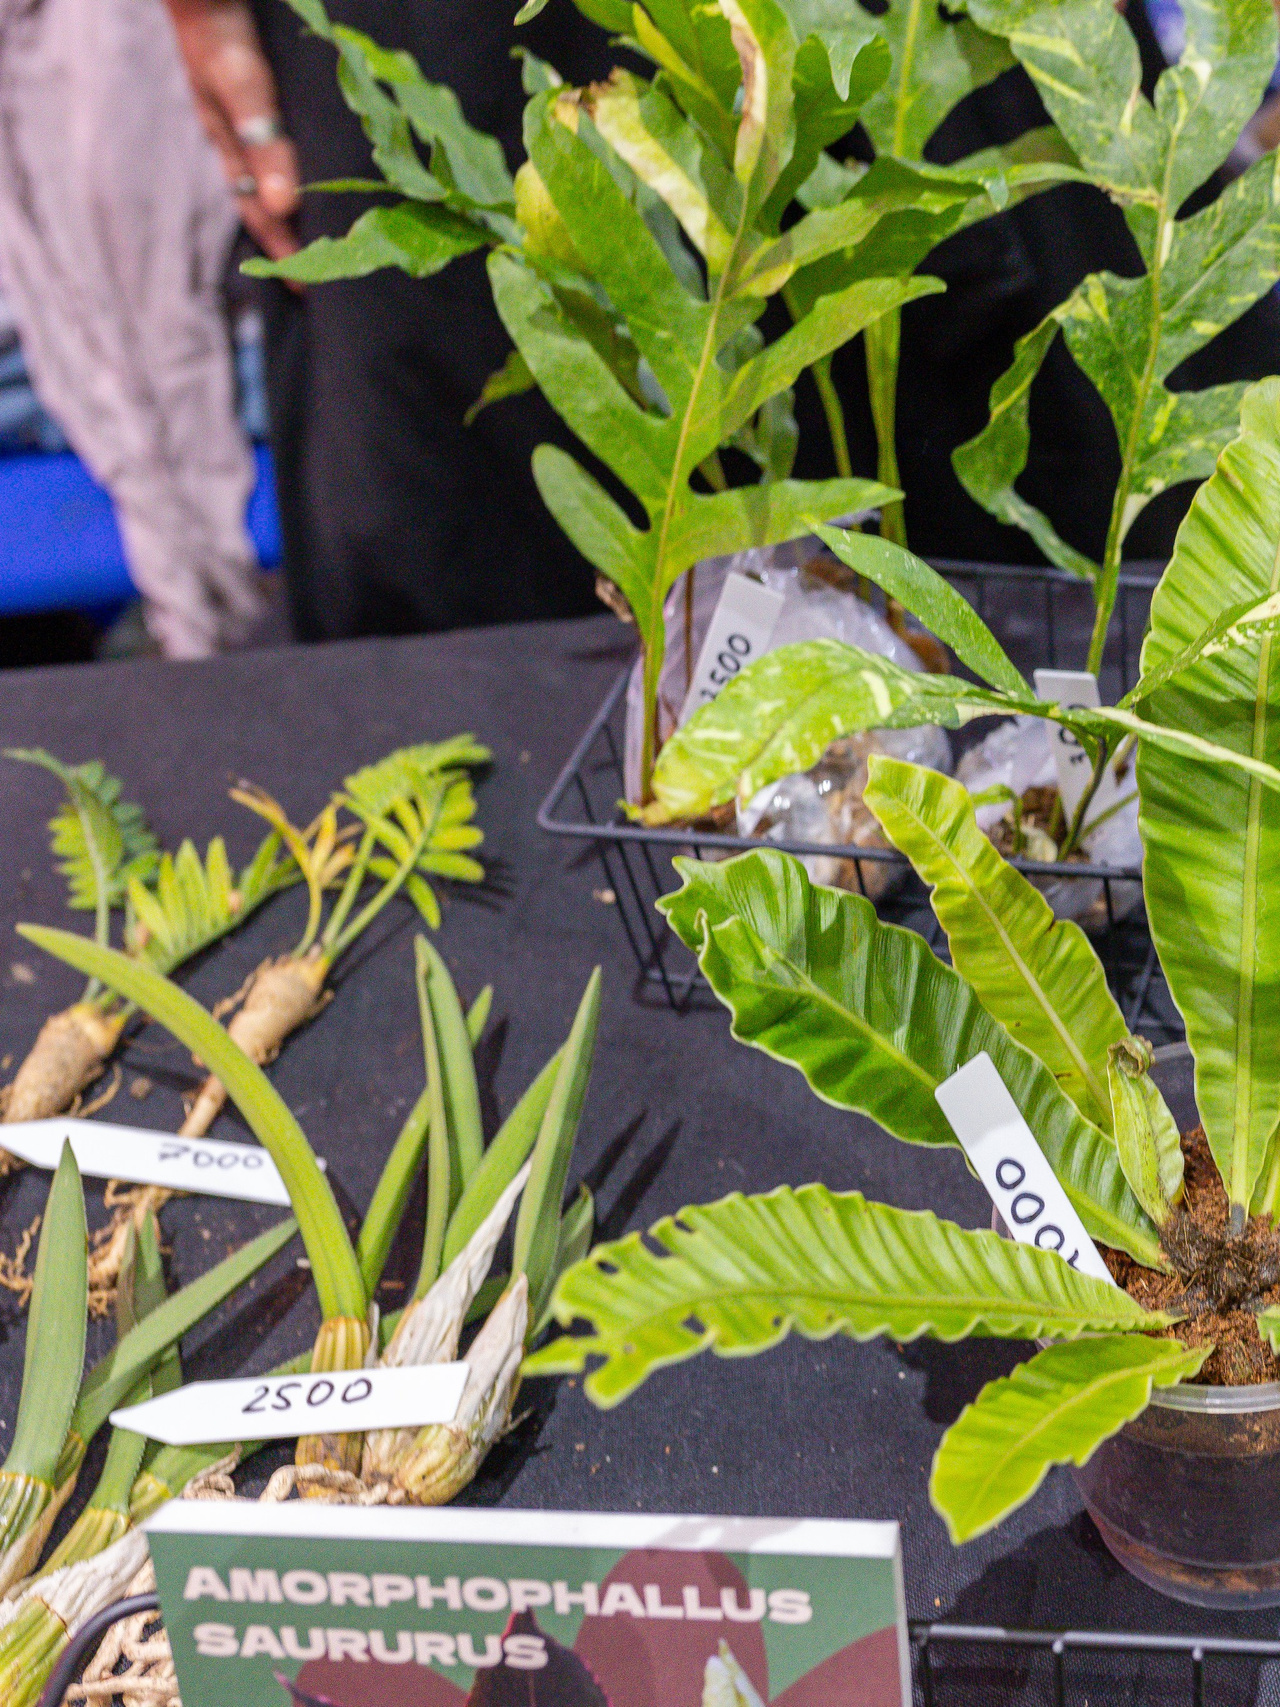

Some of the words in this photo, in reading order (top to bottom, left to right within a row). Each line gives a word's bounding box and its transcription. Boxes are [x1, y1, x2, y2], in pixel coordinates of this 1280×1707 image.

[995, 1156, 1081, 1262] 000
[241, 1377, 373, 1413] 2500
[183, 1566, 813, 1625] AMORPHOPHALLUS
[193, 1622, 549, 1671] SAURURUS
